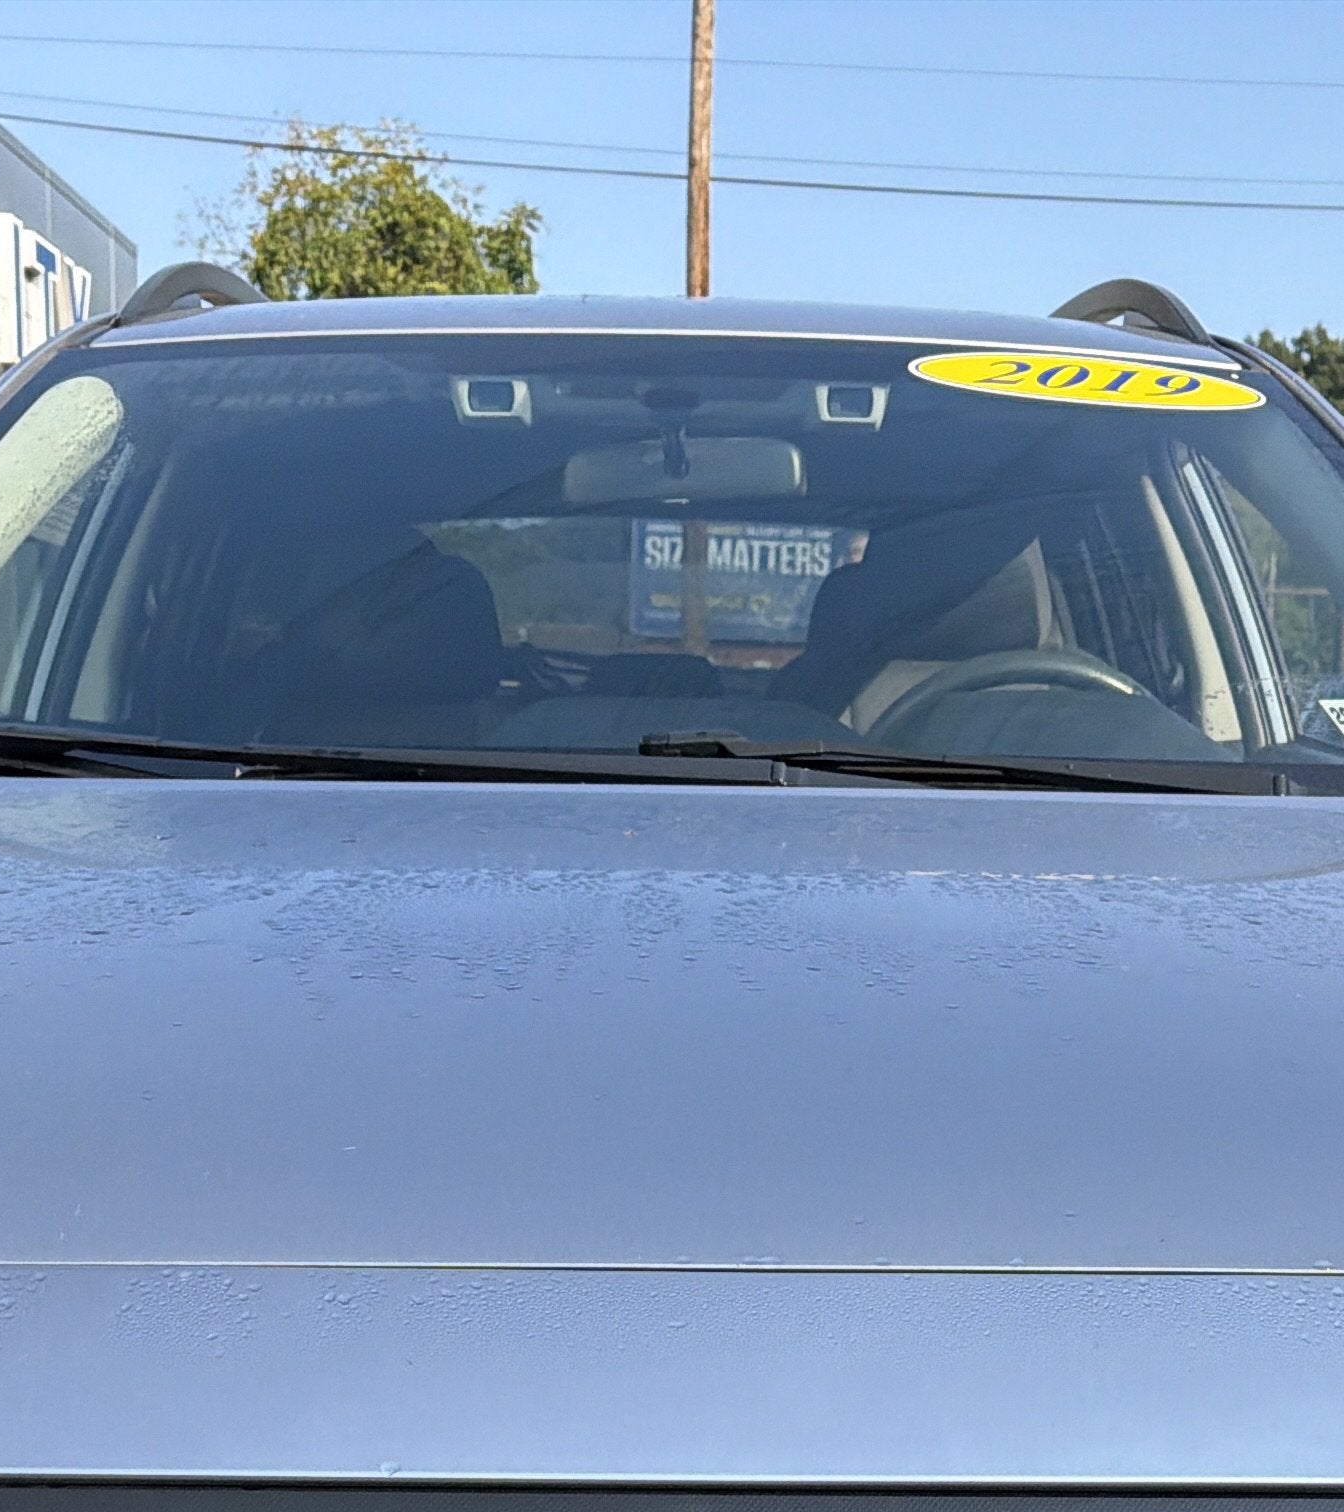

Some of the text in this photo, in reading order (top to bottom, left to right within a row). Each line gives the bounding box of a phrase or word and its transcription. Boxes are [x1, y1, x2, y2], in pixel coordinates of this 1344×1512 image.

[974, 360, 1202, 397] 2019
[644, 535, 830, 577] SIZ MATTERS
